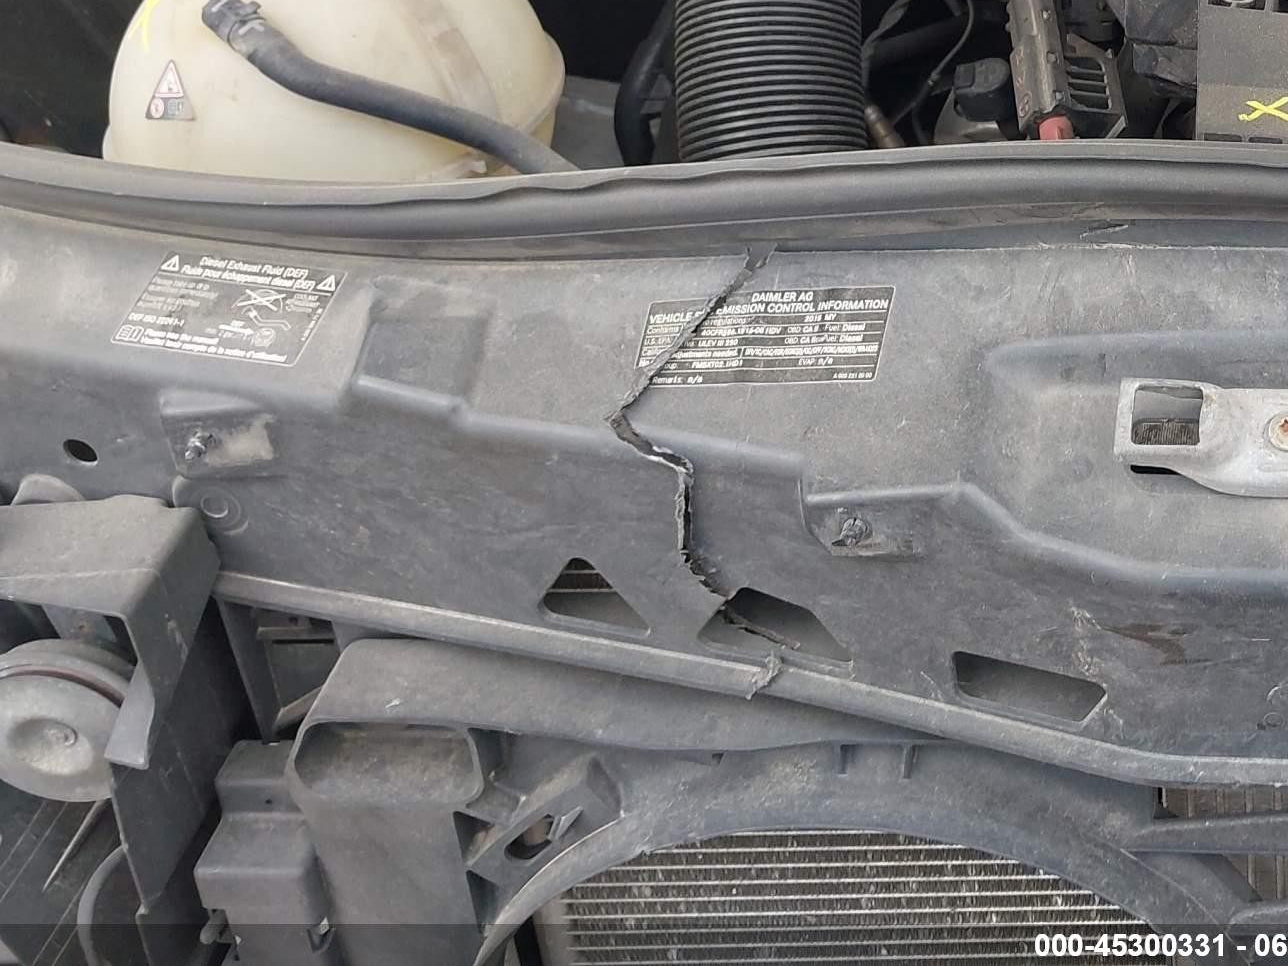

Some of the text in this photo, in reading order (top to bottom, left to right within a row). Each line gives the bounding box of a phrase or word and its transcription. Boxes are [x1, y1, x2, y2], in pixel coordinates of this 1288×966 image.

[200, 256, 309, 280] Diesel Exhaust Fluid (DEF)
[202, 268, 223, 281] pour
[293, 279, 316, 292] (DEF)
[752, 291, 814, 302] DAIMLER AG
[128, 312, 144, 321] DEF
[648, 312, 692, 324] VEHICLE
[766, 302, 816, 313] CONTROL
[817, 298, 889, 311] INFORMATION
